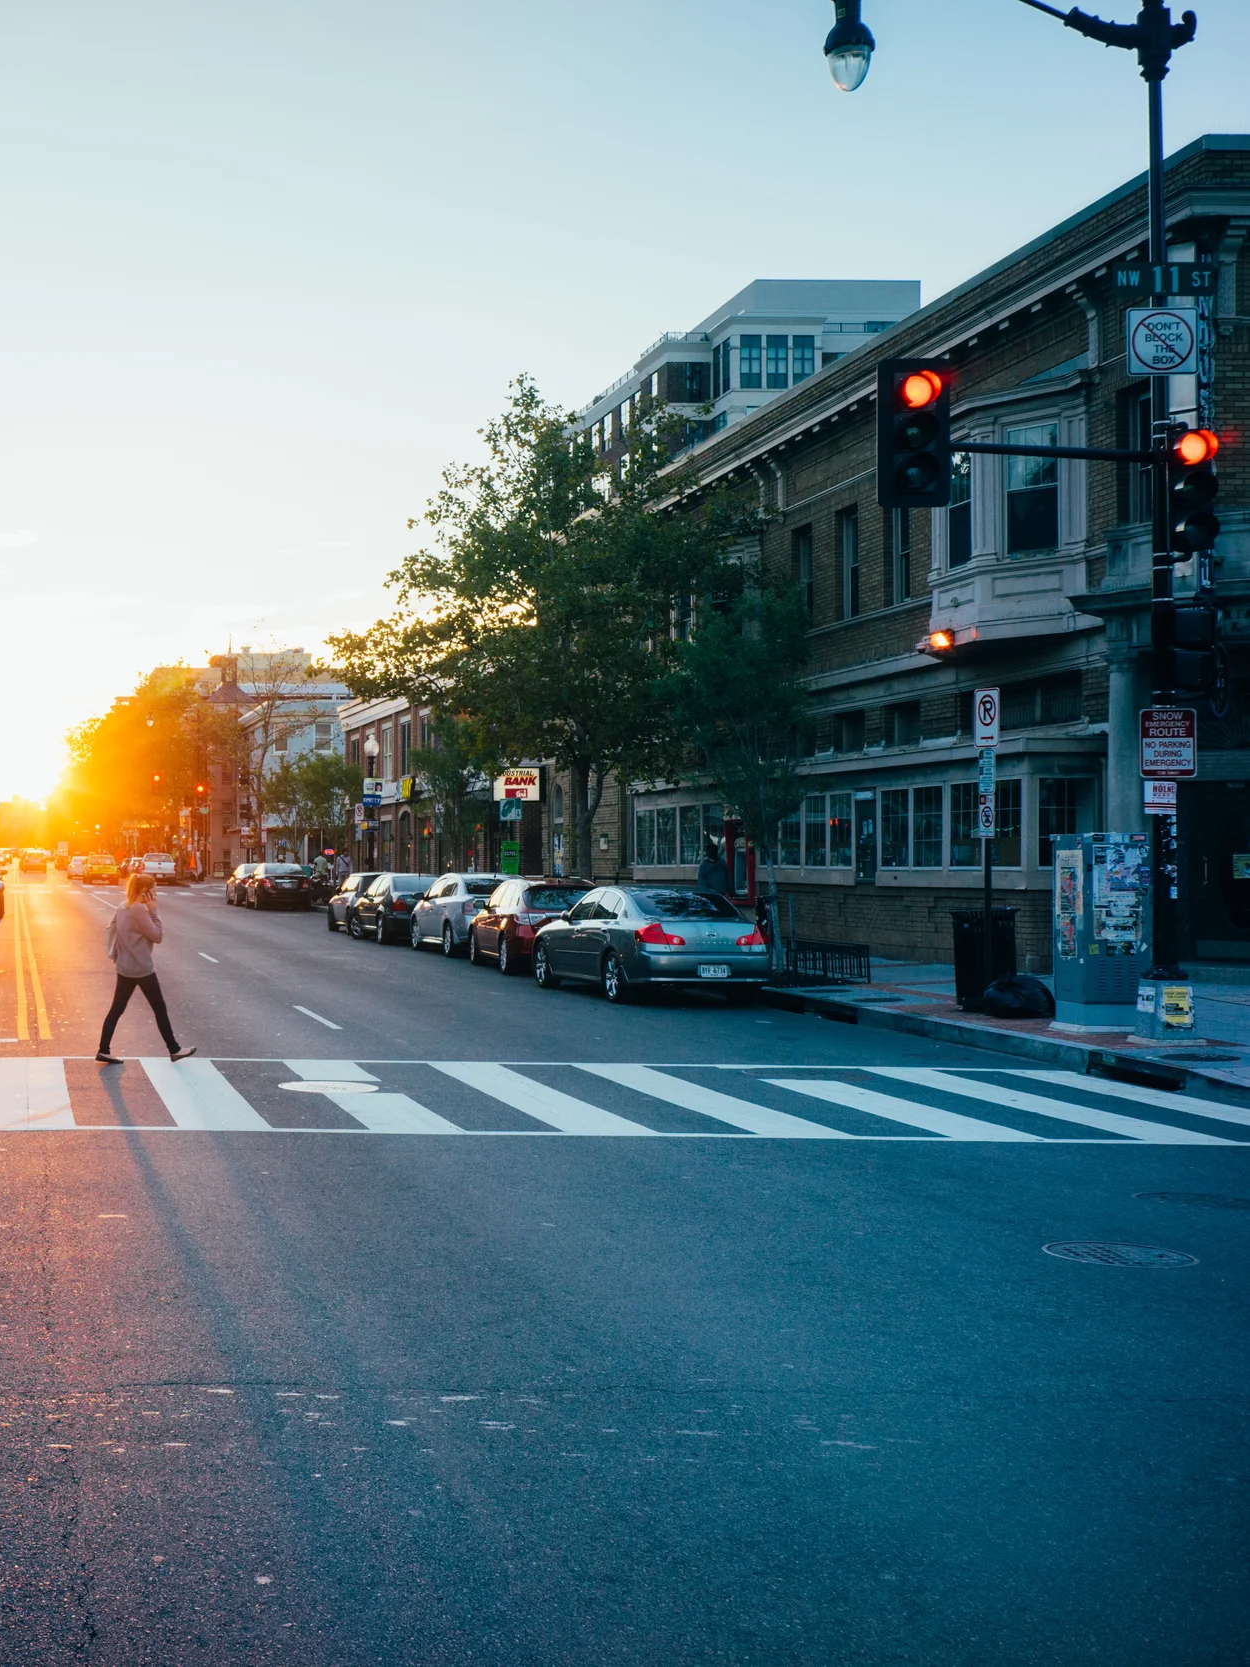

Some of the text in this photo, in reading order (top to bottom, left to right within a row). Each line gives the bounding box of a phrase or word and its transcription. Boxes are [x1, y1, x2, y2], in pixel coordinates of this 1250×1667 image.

[1117, 265, 1211, 293] NW 11 ST
[1147, 322, 1181, 331] DON'T
[1145, 333, 1183, 342] BLOCK
[1154, 344, 1175, 353] THE
[1152, 356, 1176, 365] BOX
[1152, 712, 1183, 720] SNOW
[1149, 728, 1187, 736] ROUTE
[503, 769, 533, 777] DUSTRIAL
[503, 776, 538, 786] BANK
[1153, 785, 1176, 793] HOLNE
